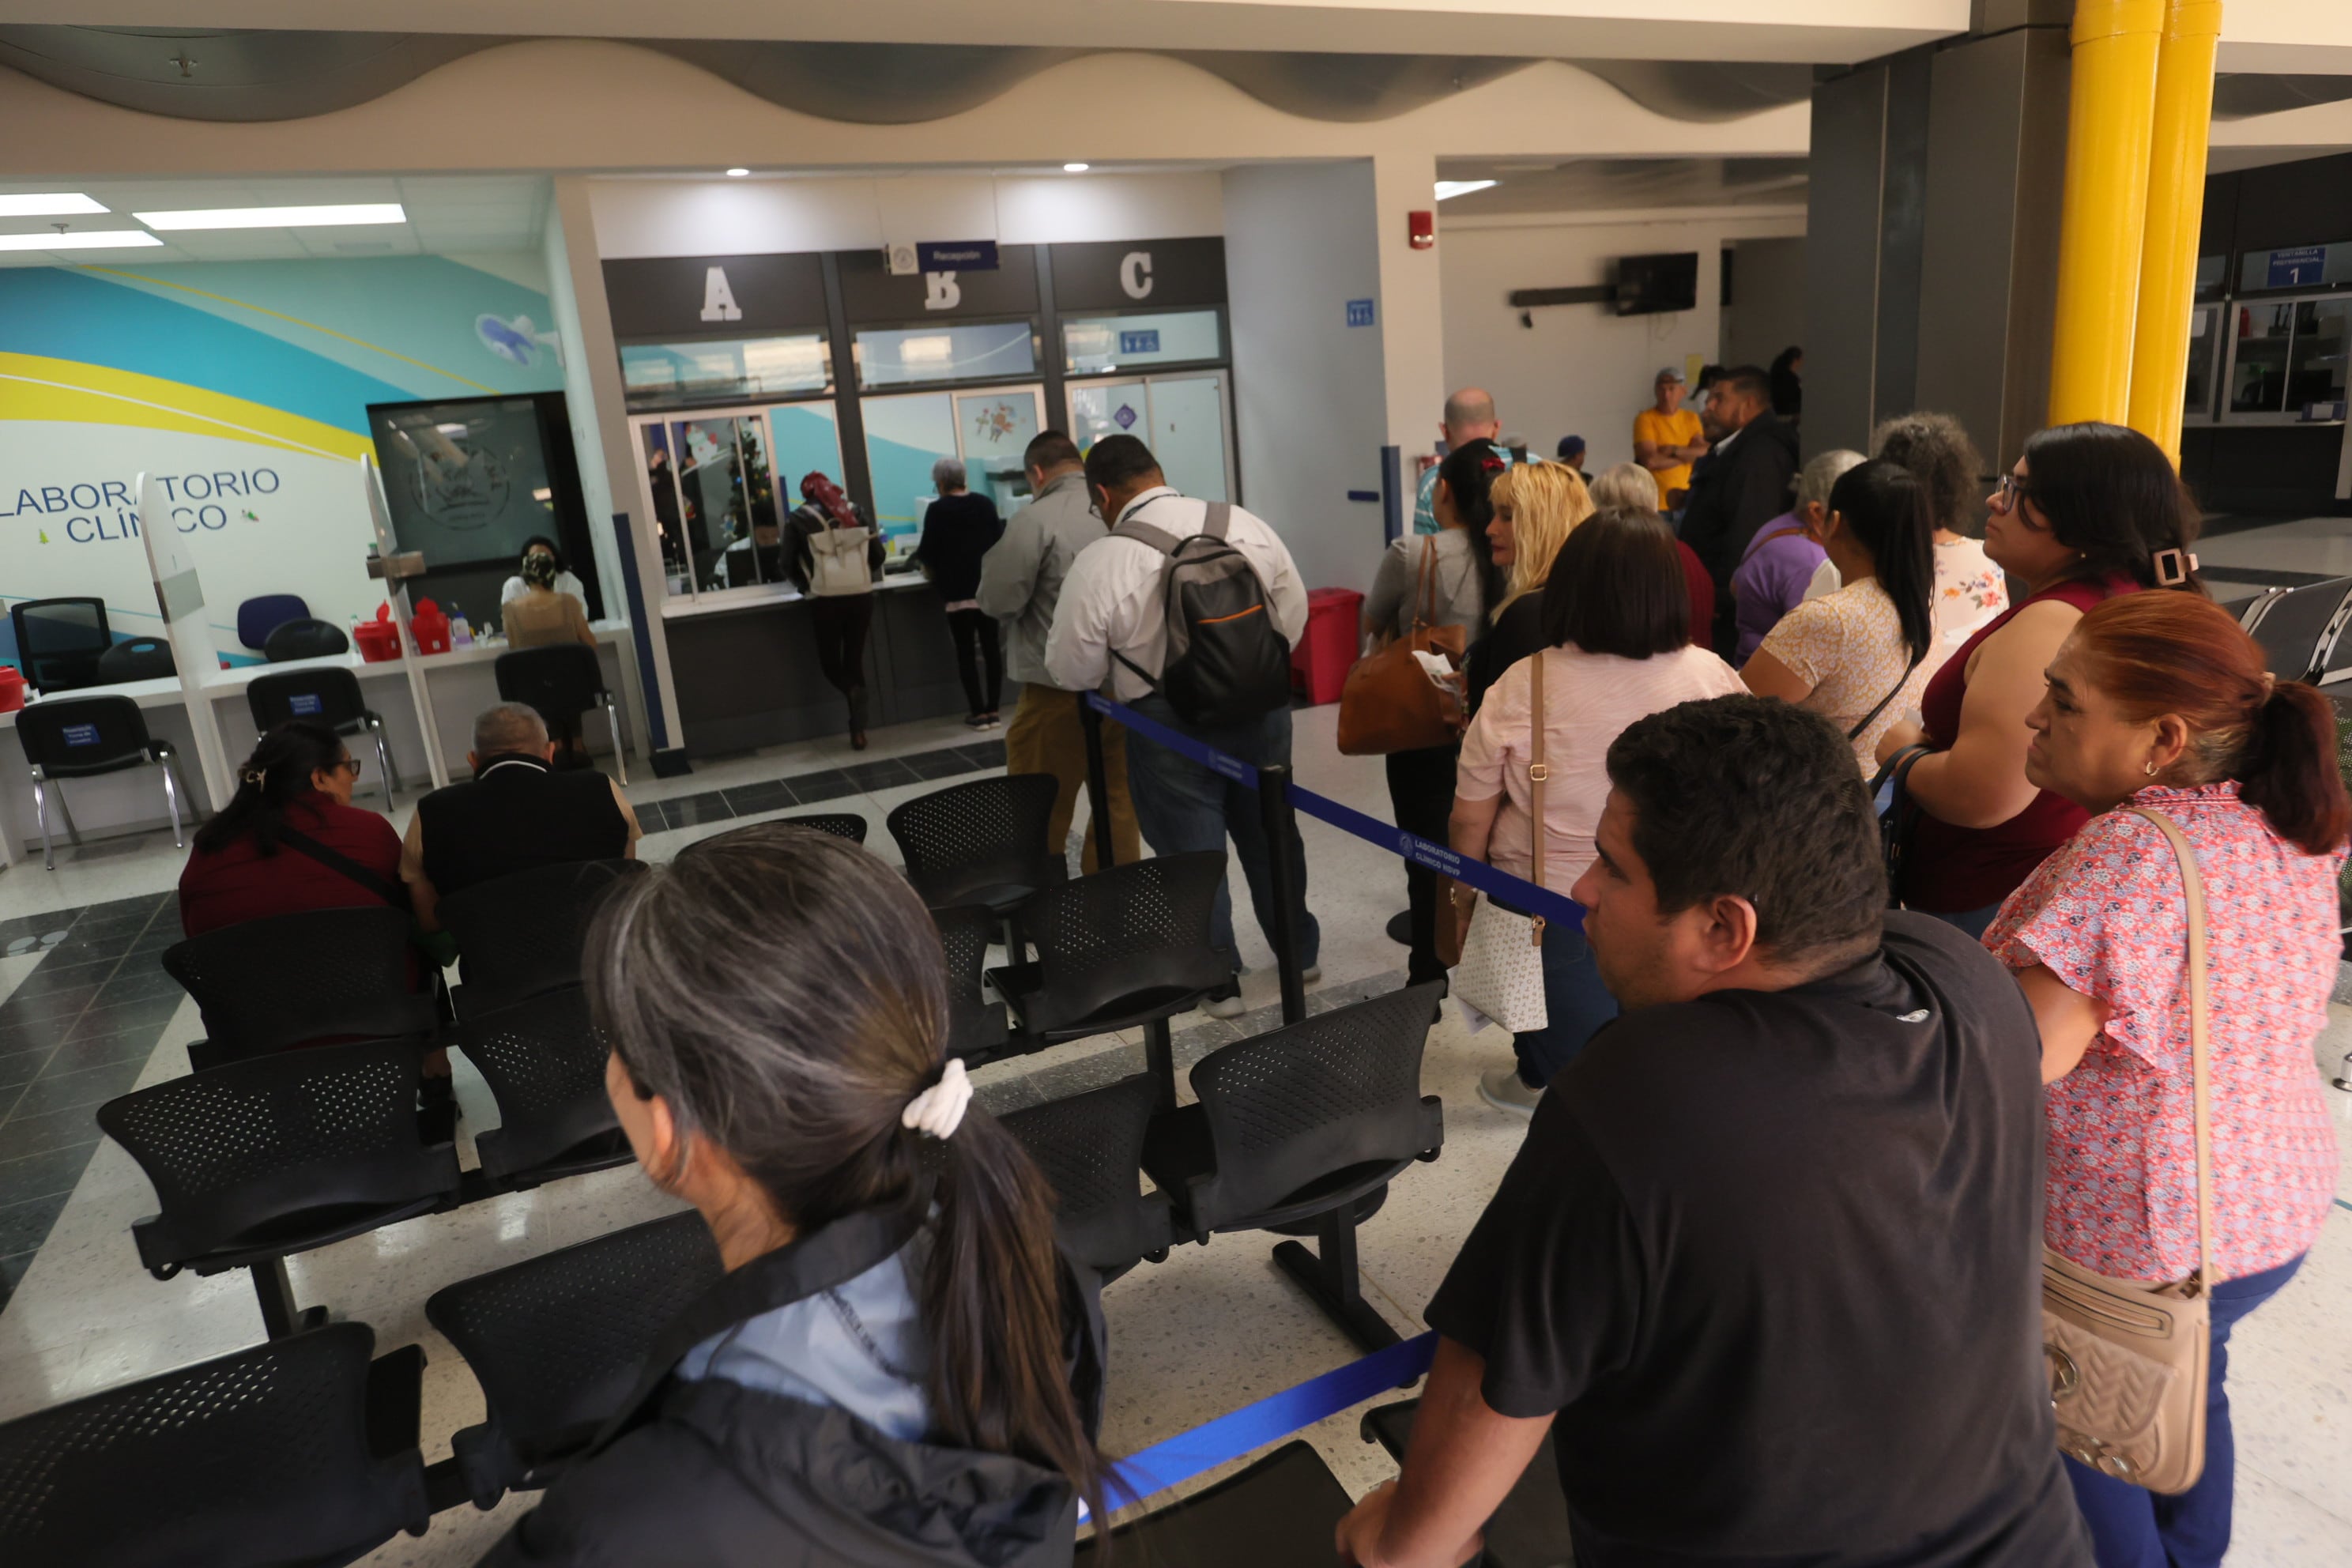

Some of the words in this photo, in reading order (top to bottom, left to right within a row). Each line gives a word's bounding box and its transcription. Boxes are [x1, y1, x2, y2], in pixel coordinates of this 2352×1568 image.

[700, 266, 742, 322] A
[925, 270, 960, 310] B
[1121, 252, 1152, 299] C
[2290, 267, 2299, 284] 1
[0, 468, 281, 517] ABORTORIO
[1415, 839, 1461, 865] LABORATORIO
